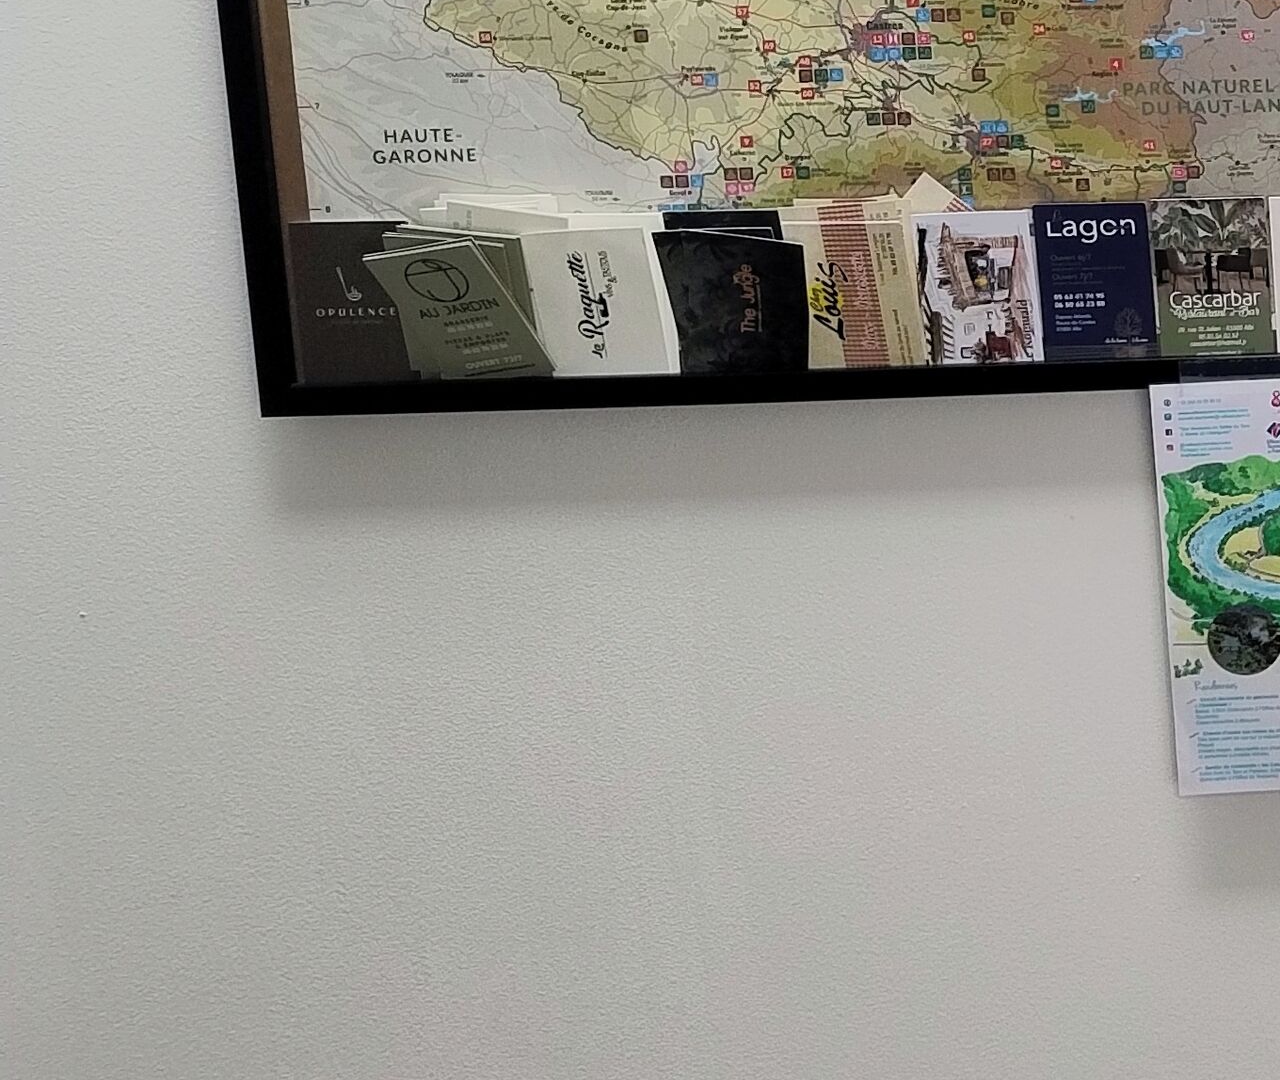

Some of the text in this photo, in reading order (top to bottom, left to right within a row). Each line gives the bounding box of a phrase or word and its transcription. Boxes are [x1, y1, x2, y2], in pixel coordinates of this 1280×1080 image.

[561, 12, 575, 25] de
[577, 25, 628, 53] Cocagne
[866, 21, 903, 31] Castres
[1122, 81, 1177, 96] PARC
[1183, 78, 1274, 94] NATUREL
[1142, 101, 1170, 115] DU
[384, 127, 463, 144] HAUTE-
[373, 148, 477, 165] GARONNE
[1046, 218, 1136, 244] Lagon
[567, 251, 609, 340] Raquette
[733, 264, 760, 333] The Jungle
[813, 261, 848, 341] Louis
[1170, 289, 1262, 310] Cascarbar
[316, 307, 399, 318] OPULENCE
[419, 297, 500, 320] AU JARDIN
